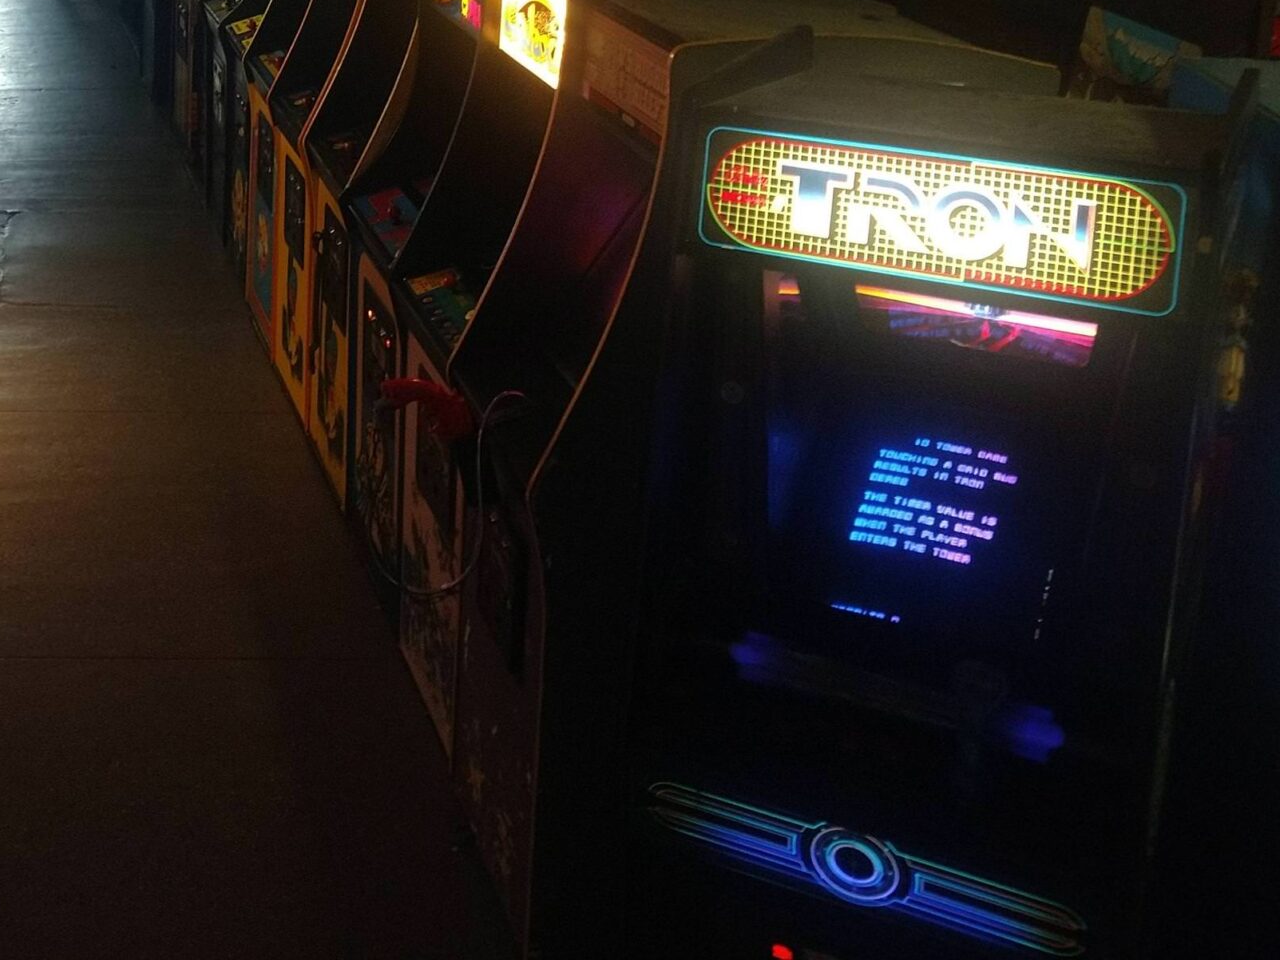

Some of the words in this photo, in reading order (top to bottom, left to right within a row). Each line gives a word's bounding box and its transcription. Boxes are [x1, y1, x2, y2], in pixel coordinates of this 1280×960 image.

[778, 159, 1098, 274] TRON
[879, 449, 940, 467] TOUCHING
[943, 461, 953, 470] A
[957, 464, 988, 477] GRID
[936, 442, 972, 455] TOWER
[977, 451, 1008, 464] GAME
[873, 460, 928, 477] RESULTS
[934, 471, 949, 480] IN
[954, 475, 985, 489] TRON
[864, 491, 889, 503] THE
[894, 496, 932, 511] TIMER
[937, 505, 975, 521] VALUE
[981, 515, 998, 527] IS
[854, 517, 887, 531] WHEN
[893, 524, 916, 536] THE
[921, 529, 967, 548] PLAYER
[918, 515, 935, 526] AS
[939, 519, 949, 529] A
[954, 523, 994, 540] BONUS
[849, 531, 897, 547] ENTERS
[904, 540, 926, 553] THE
[933, 547, 971, 564] TOWER
